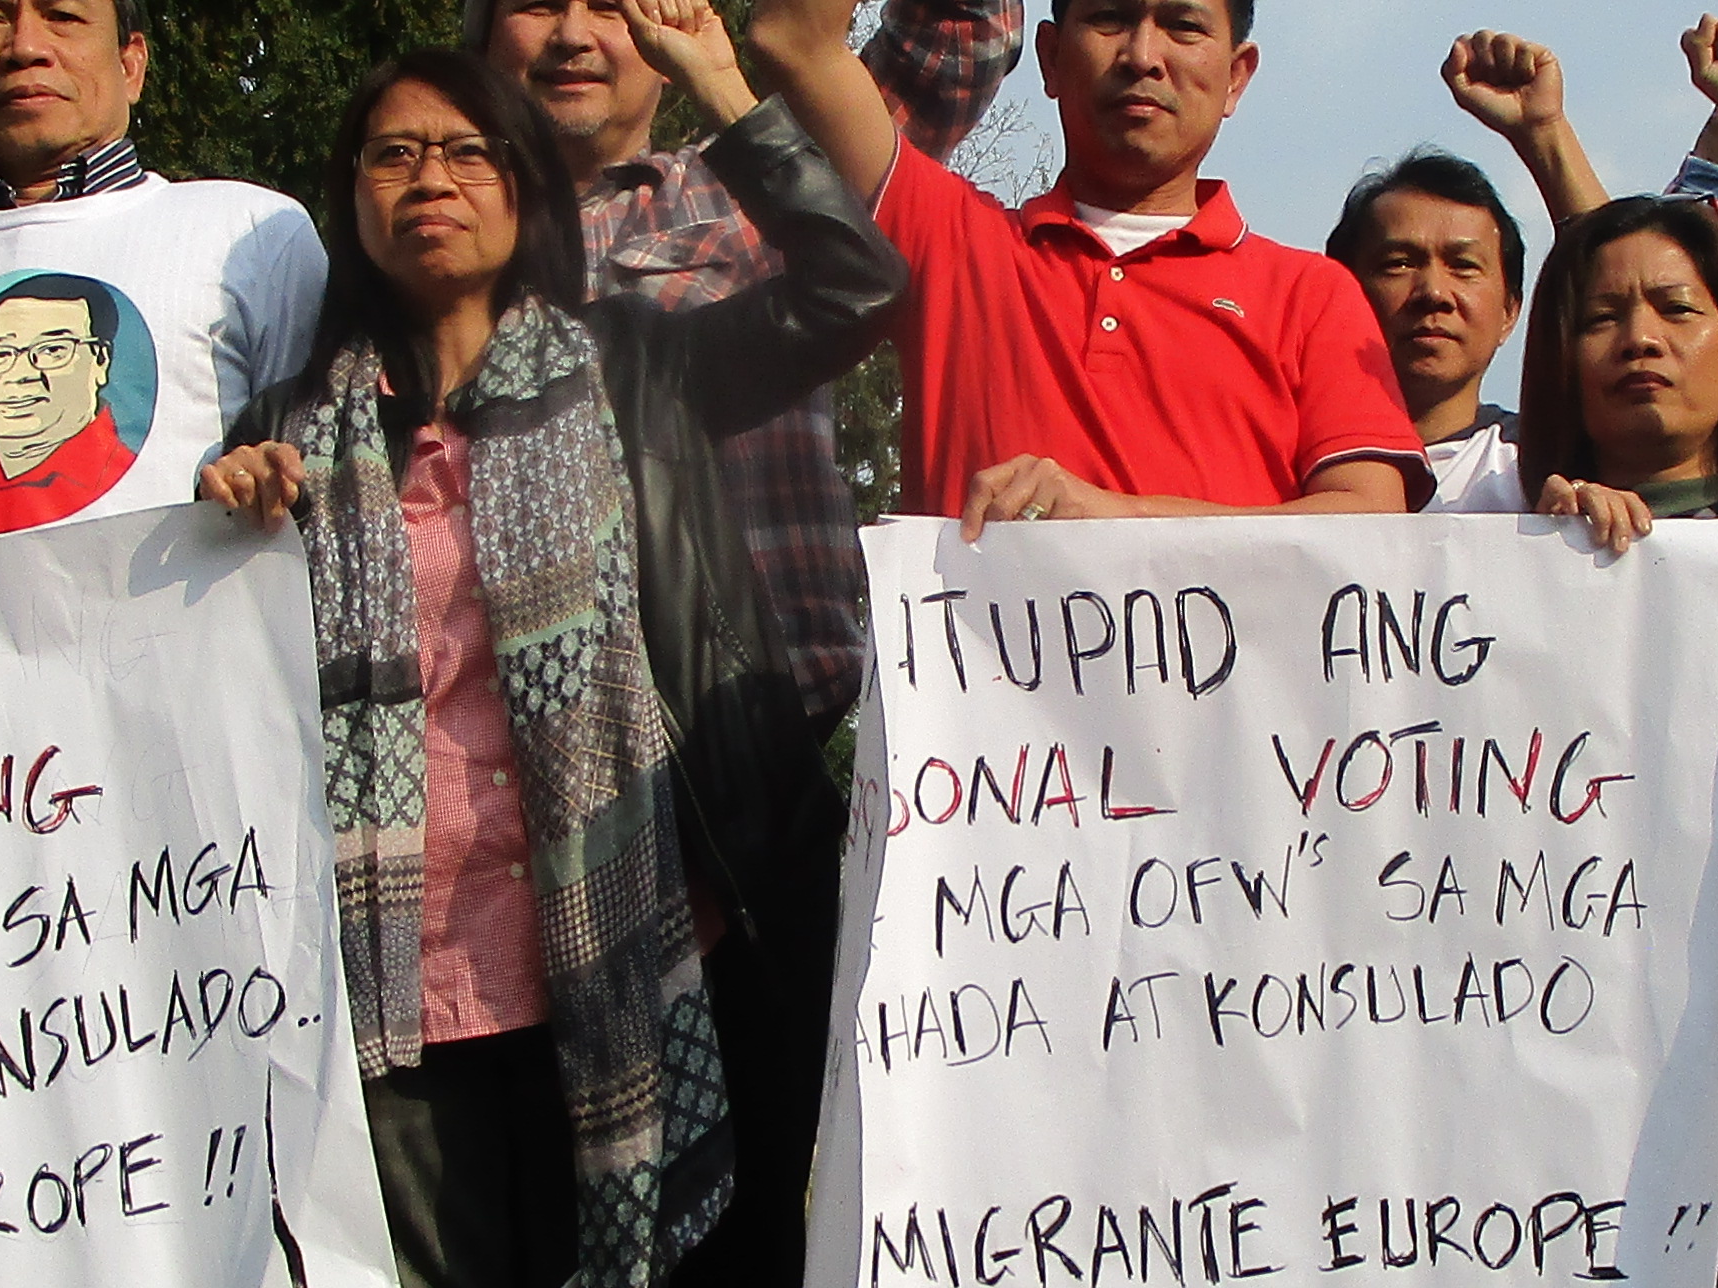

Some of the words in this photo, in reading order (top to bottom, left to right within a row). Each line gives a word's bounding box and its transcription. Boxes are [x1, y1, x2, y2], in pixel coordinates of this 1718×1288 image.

[1320, 582, 1498, 687] ANG
[1270, 719, 1637, 826] VOTING
[2, 872, 97, 968] SA
[129, 825, 273, 944] MGA
[934, 858, 1092, 960] MGA
[1377, 849, 1468, 926] SA
[1494, 848, 1649, 938] MGA
[1102, 971, 1181, 1053] AT
[1203, 950, 1596, 1049] KONSULADO
[1318, 1191, 1630, 1282] EUROPE
